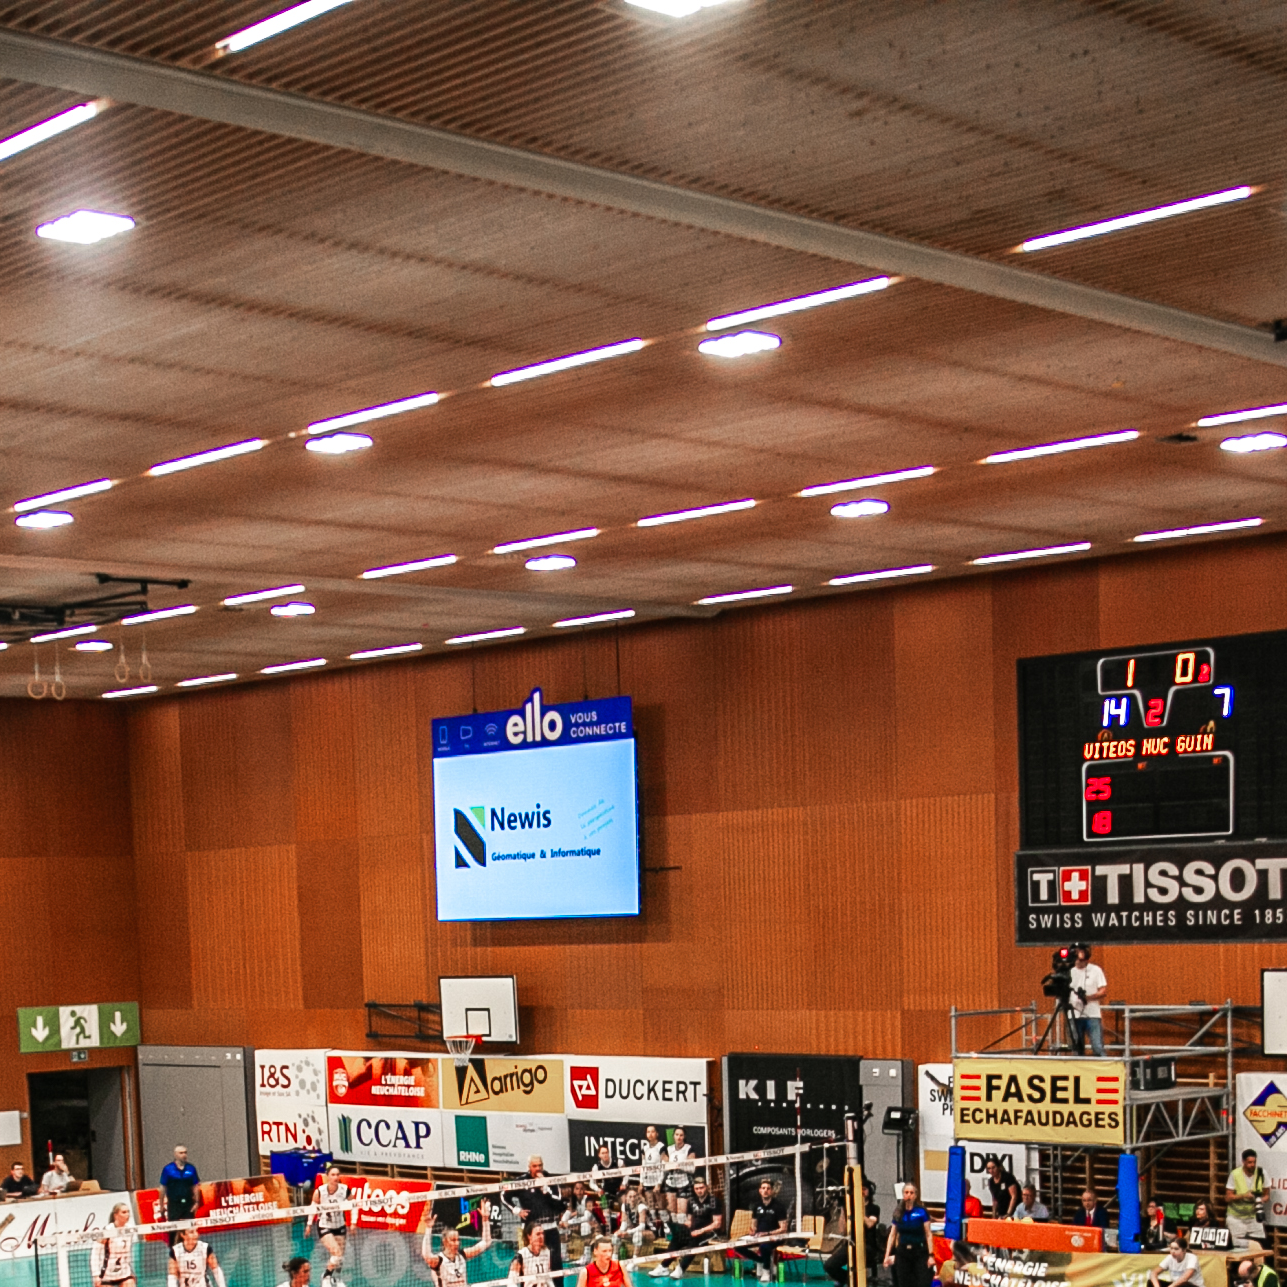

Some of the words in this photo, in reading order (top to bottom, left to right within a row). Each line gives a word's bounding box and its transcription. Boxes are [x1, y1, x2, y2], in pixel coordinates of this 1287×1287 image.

[1175, 652, 1196, 683] 0
[1102, 696, 1131, 727] 14
[1145, 699, 1165, 726] 2
[1214, 685, 1234, 718] 7
[506, 691, 562, 744] ello
[570, 711, 597, 723] VOUS
[570, 722, 627, 738] CONNECTE
[1084, 739, 1135, 760] VITEOS
[1085, 777, 1112, 800] 25
[490, 803, 552, 831] Newis
[491, 851, 535, 862] Géomatique
[550, 847, 601, 860] Informatique
[1029, 913, 1083, 928] SWISS
[1092, 910, 1176, 927] WATCHES
[1187, 909, 1242, 924] SINCE
[260, 1064, 291, 1089] I&S
[381, 1073, 415, 1085] L'ÉNERGIE
[490, 1064, 547, 1095] arrigo
[605, 1078, 701, 1102] DUCKERT
[738, 1079, 804, 1100] KIF
[985, 1074, 1092, 1105] FASEL
[959, 1106, 1120, 1129] ECHAFAUDAGES
[261, 1121, 298, 1144] RTN
[356, 1118, 431, 1149] CCAP
[753, 1126, 795, 1136] COMPOSANTS
[797, 1129, 835, 1138] ORLOGERS
[221, 1192, 265, 1207] L'ÉNERGIE
[976, 1252, 1049, 1277] L'ÉNERGIE
